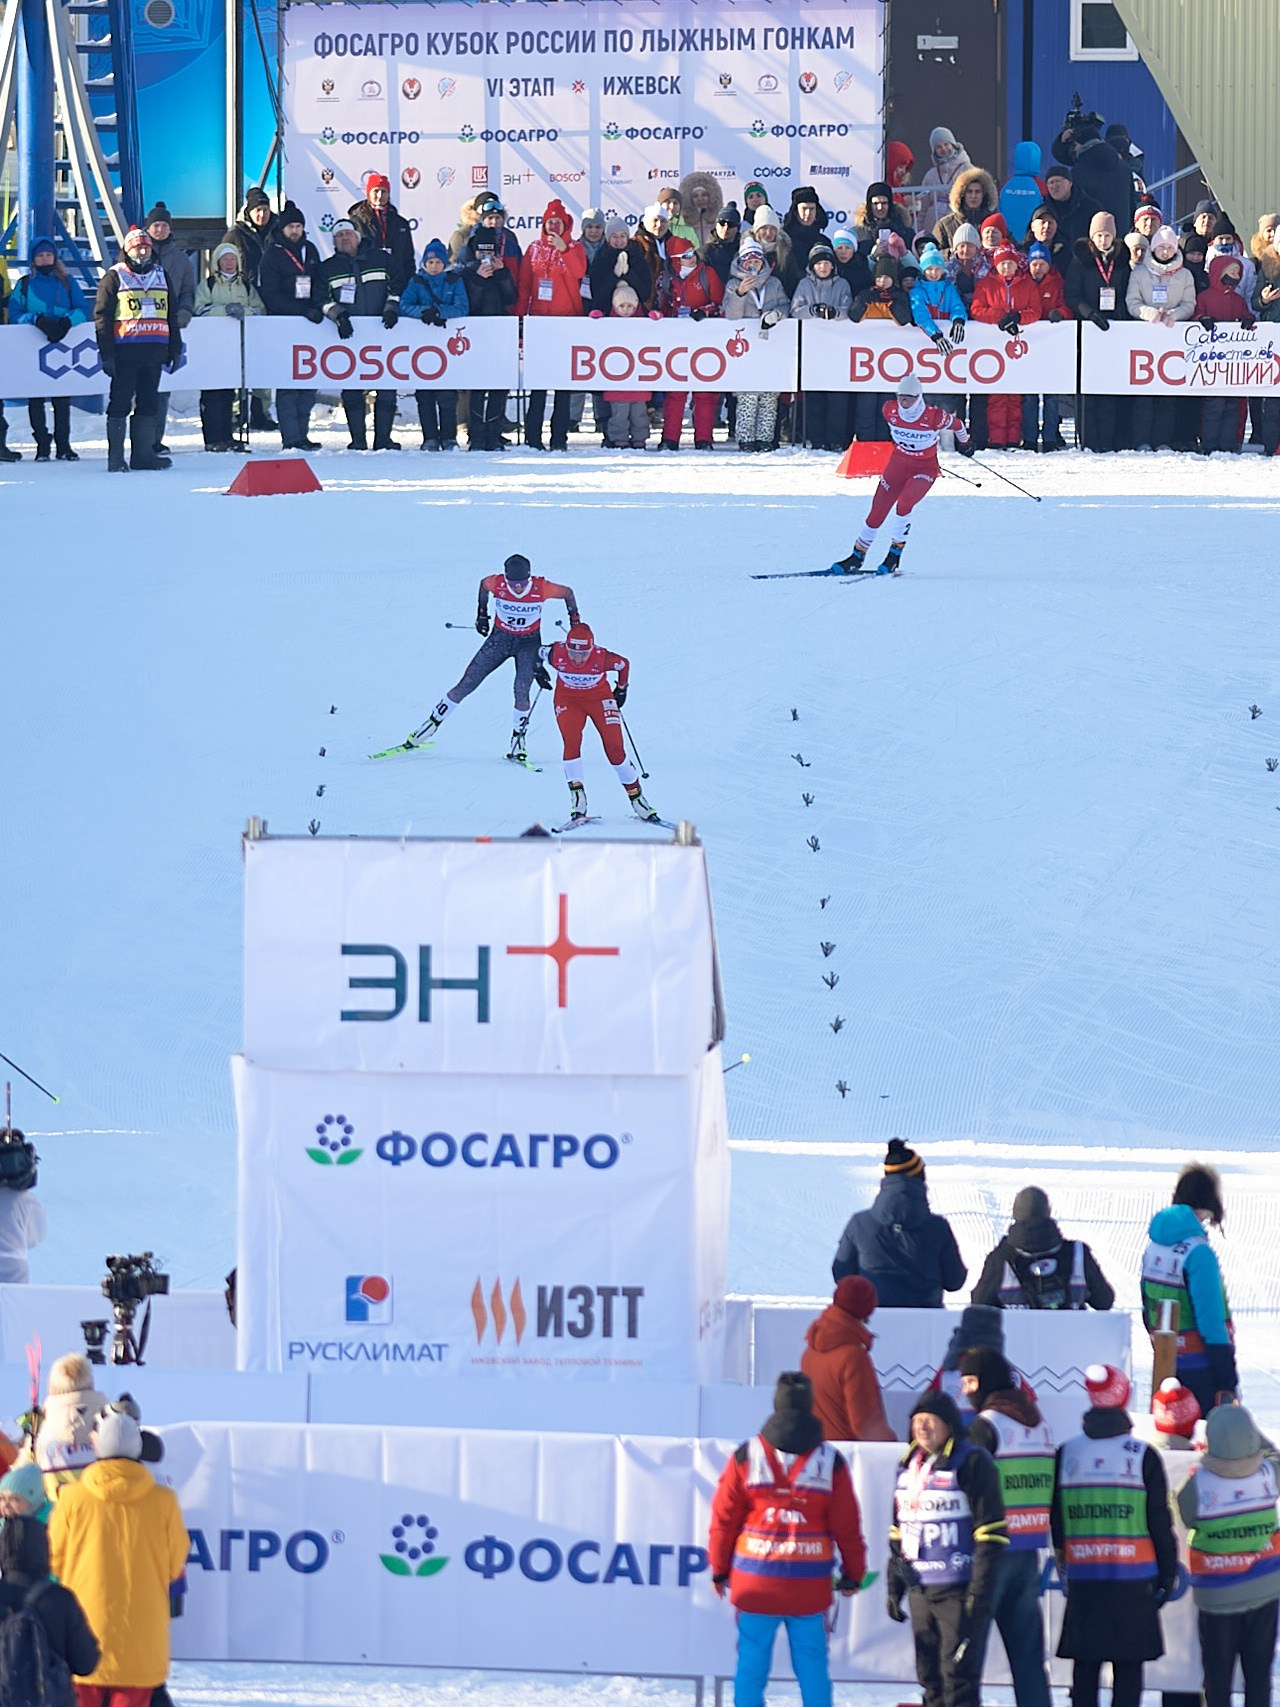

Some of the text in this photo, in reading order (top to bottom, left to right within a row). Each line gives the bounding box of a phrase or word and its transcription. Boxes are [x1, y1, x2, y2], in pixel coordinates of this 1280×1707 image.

[314, 26, 855, 58] ФОСАГРО КУБОК РОССИИ ПО ЛЫЖНЫМ ГОНКАМ
[487, 77, 554, 97] VI ЭТАП
[603, 75, 682, 96] ИЖЕВСК
[341, 131, 420, 145] ФОСАГРО
[480, 128, 558, 143] ФОСАГРО
[625, 126, 704, 140] ФОСАГРО
[770, 123, 849, 138] ФОСАГРО
[549, 173, 581, 183] BOSCO
[660, 170, 679, 178] ПСБ
[753, 166, 792, 177] СОЮЗ
[292, 344, 447, 381] BOSCO
[571, 345, 727, 383] BOSCO
[849, 346, 1005, 385] BOSCO
[1190, 361, 1273, 386] ЛУЧШИЙ
[507, 616, 526, 626] 20
[375, 1130, 620, 1170] ФОСАГРО
[536, 1285, 645, 1338] ИЗТТ
[288, 1341, 449, 1363] РУСКЛИМАТ
[1067, 1502, 1134, 1520] ВОЛОНТЕР
[187, 1529, 329, 1573] АГРО
[463, 1534, 709, 1588] ФОСАГР
